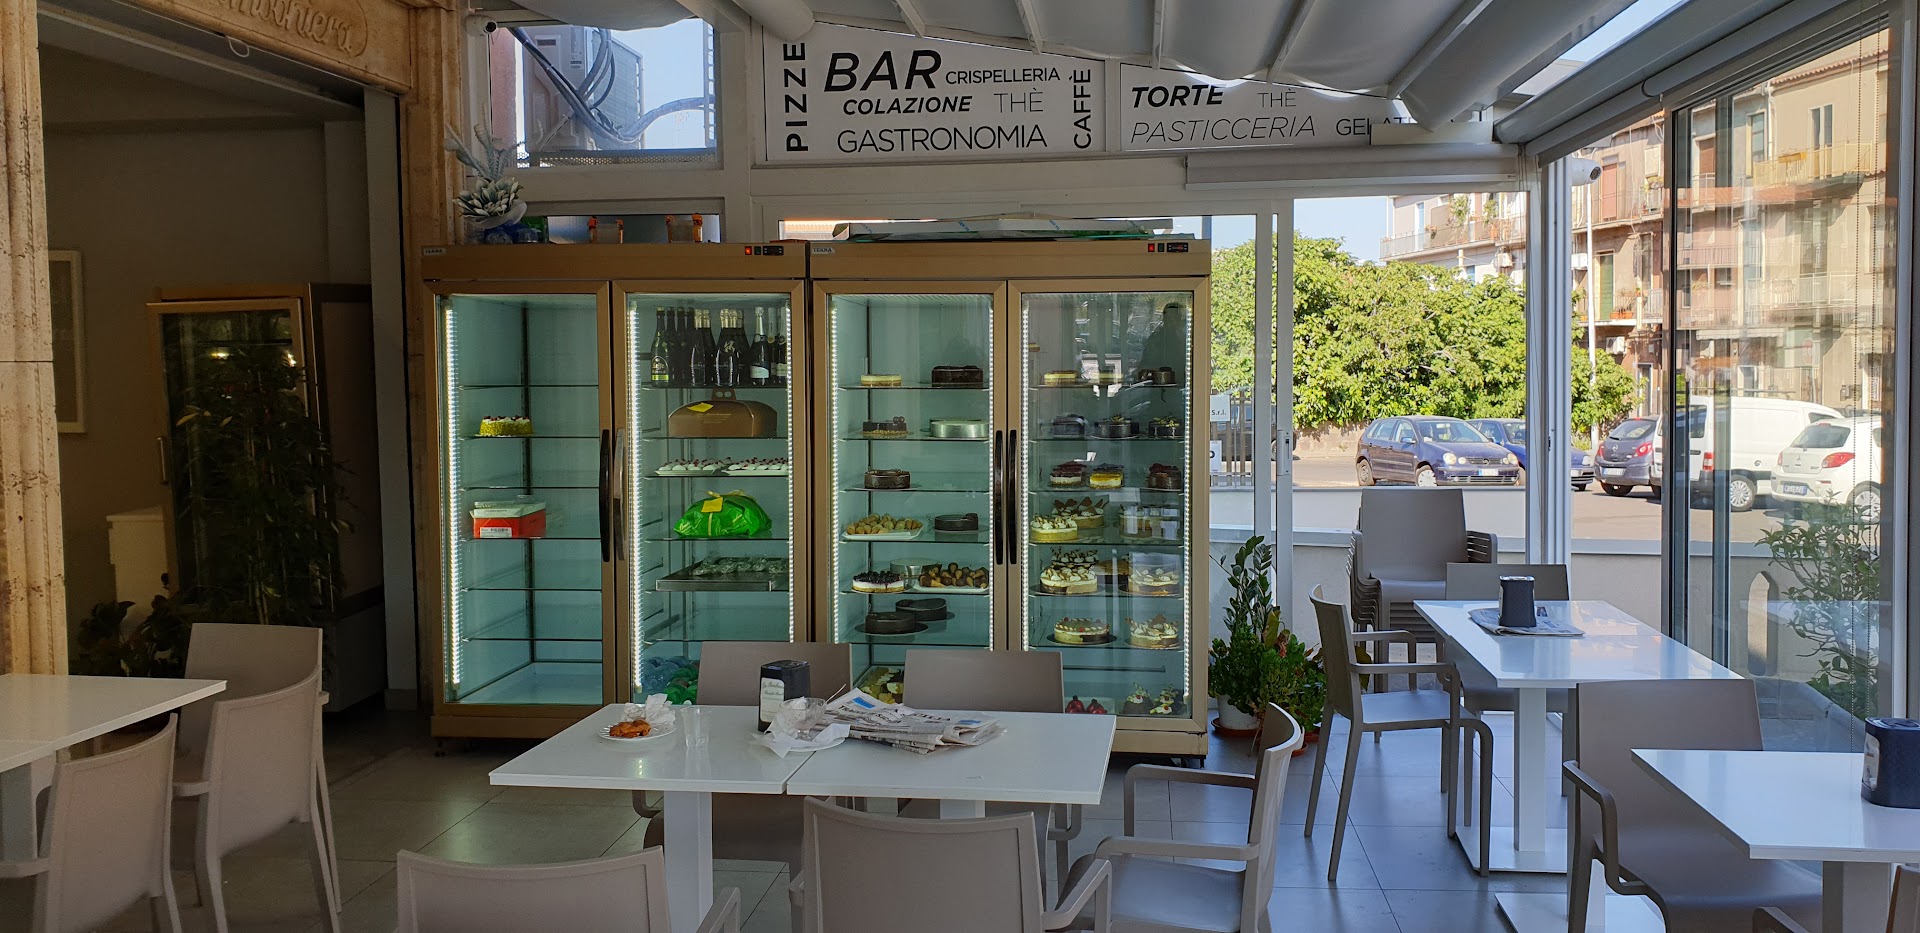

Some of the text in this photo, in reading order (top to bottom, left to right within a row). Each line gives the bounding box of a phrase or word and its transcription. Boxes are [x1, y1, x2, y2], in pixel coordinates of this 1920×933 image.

[823, 49, 942, 92] BAR
[945, 67, 1061, 85] CRISPELLERIA
[783, 42, 809, 152] PIZZE
[842, 95, 973, 116] COLAZIONE
[993, 87, 1044, 114] THÈ
[1131, 84, 1225, 109] TORTE
[1257, 87, 1297, 108] THÈ
[837, 124, 1048, 153] GASTRONOMIA
[1130, 115, 1316, 144] PASTICCERIA
